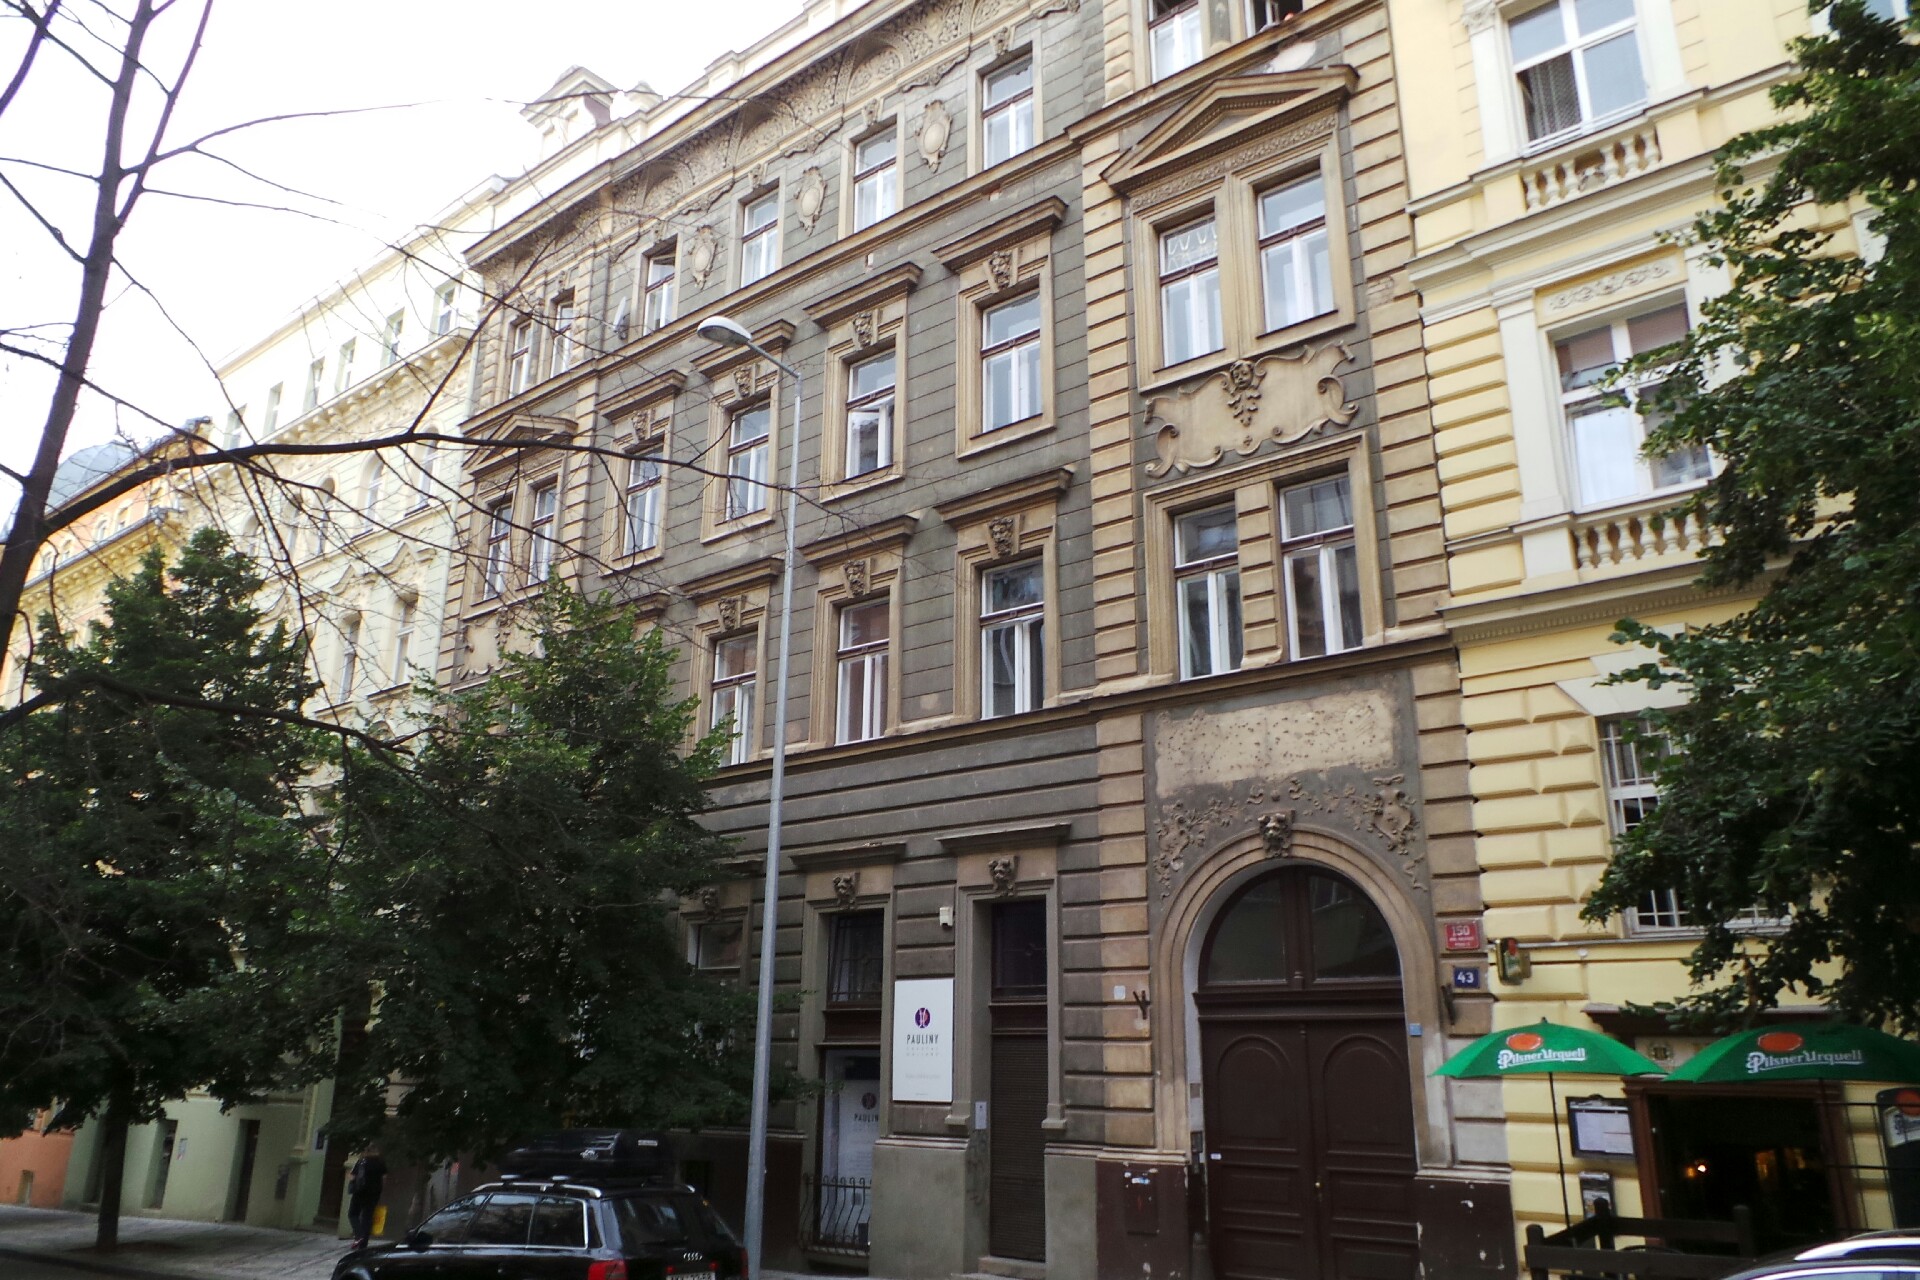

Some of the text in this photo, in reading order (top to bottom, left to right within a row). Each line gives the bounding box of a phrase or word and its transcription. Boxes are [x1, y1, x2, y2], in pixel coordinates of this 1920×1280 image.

[1457, 971, 1474, 984] 43
[906, 1033, 939, 1045] PAULINY
[1497, 1047, 1586, 1070] Pilsner Urquell
[1745, 1049, 1863, 1074] Pilsner Urquell
